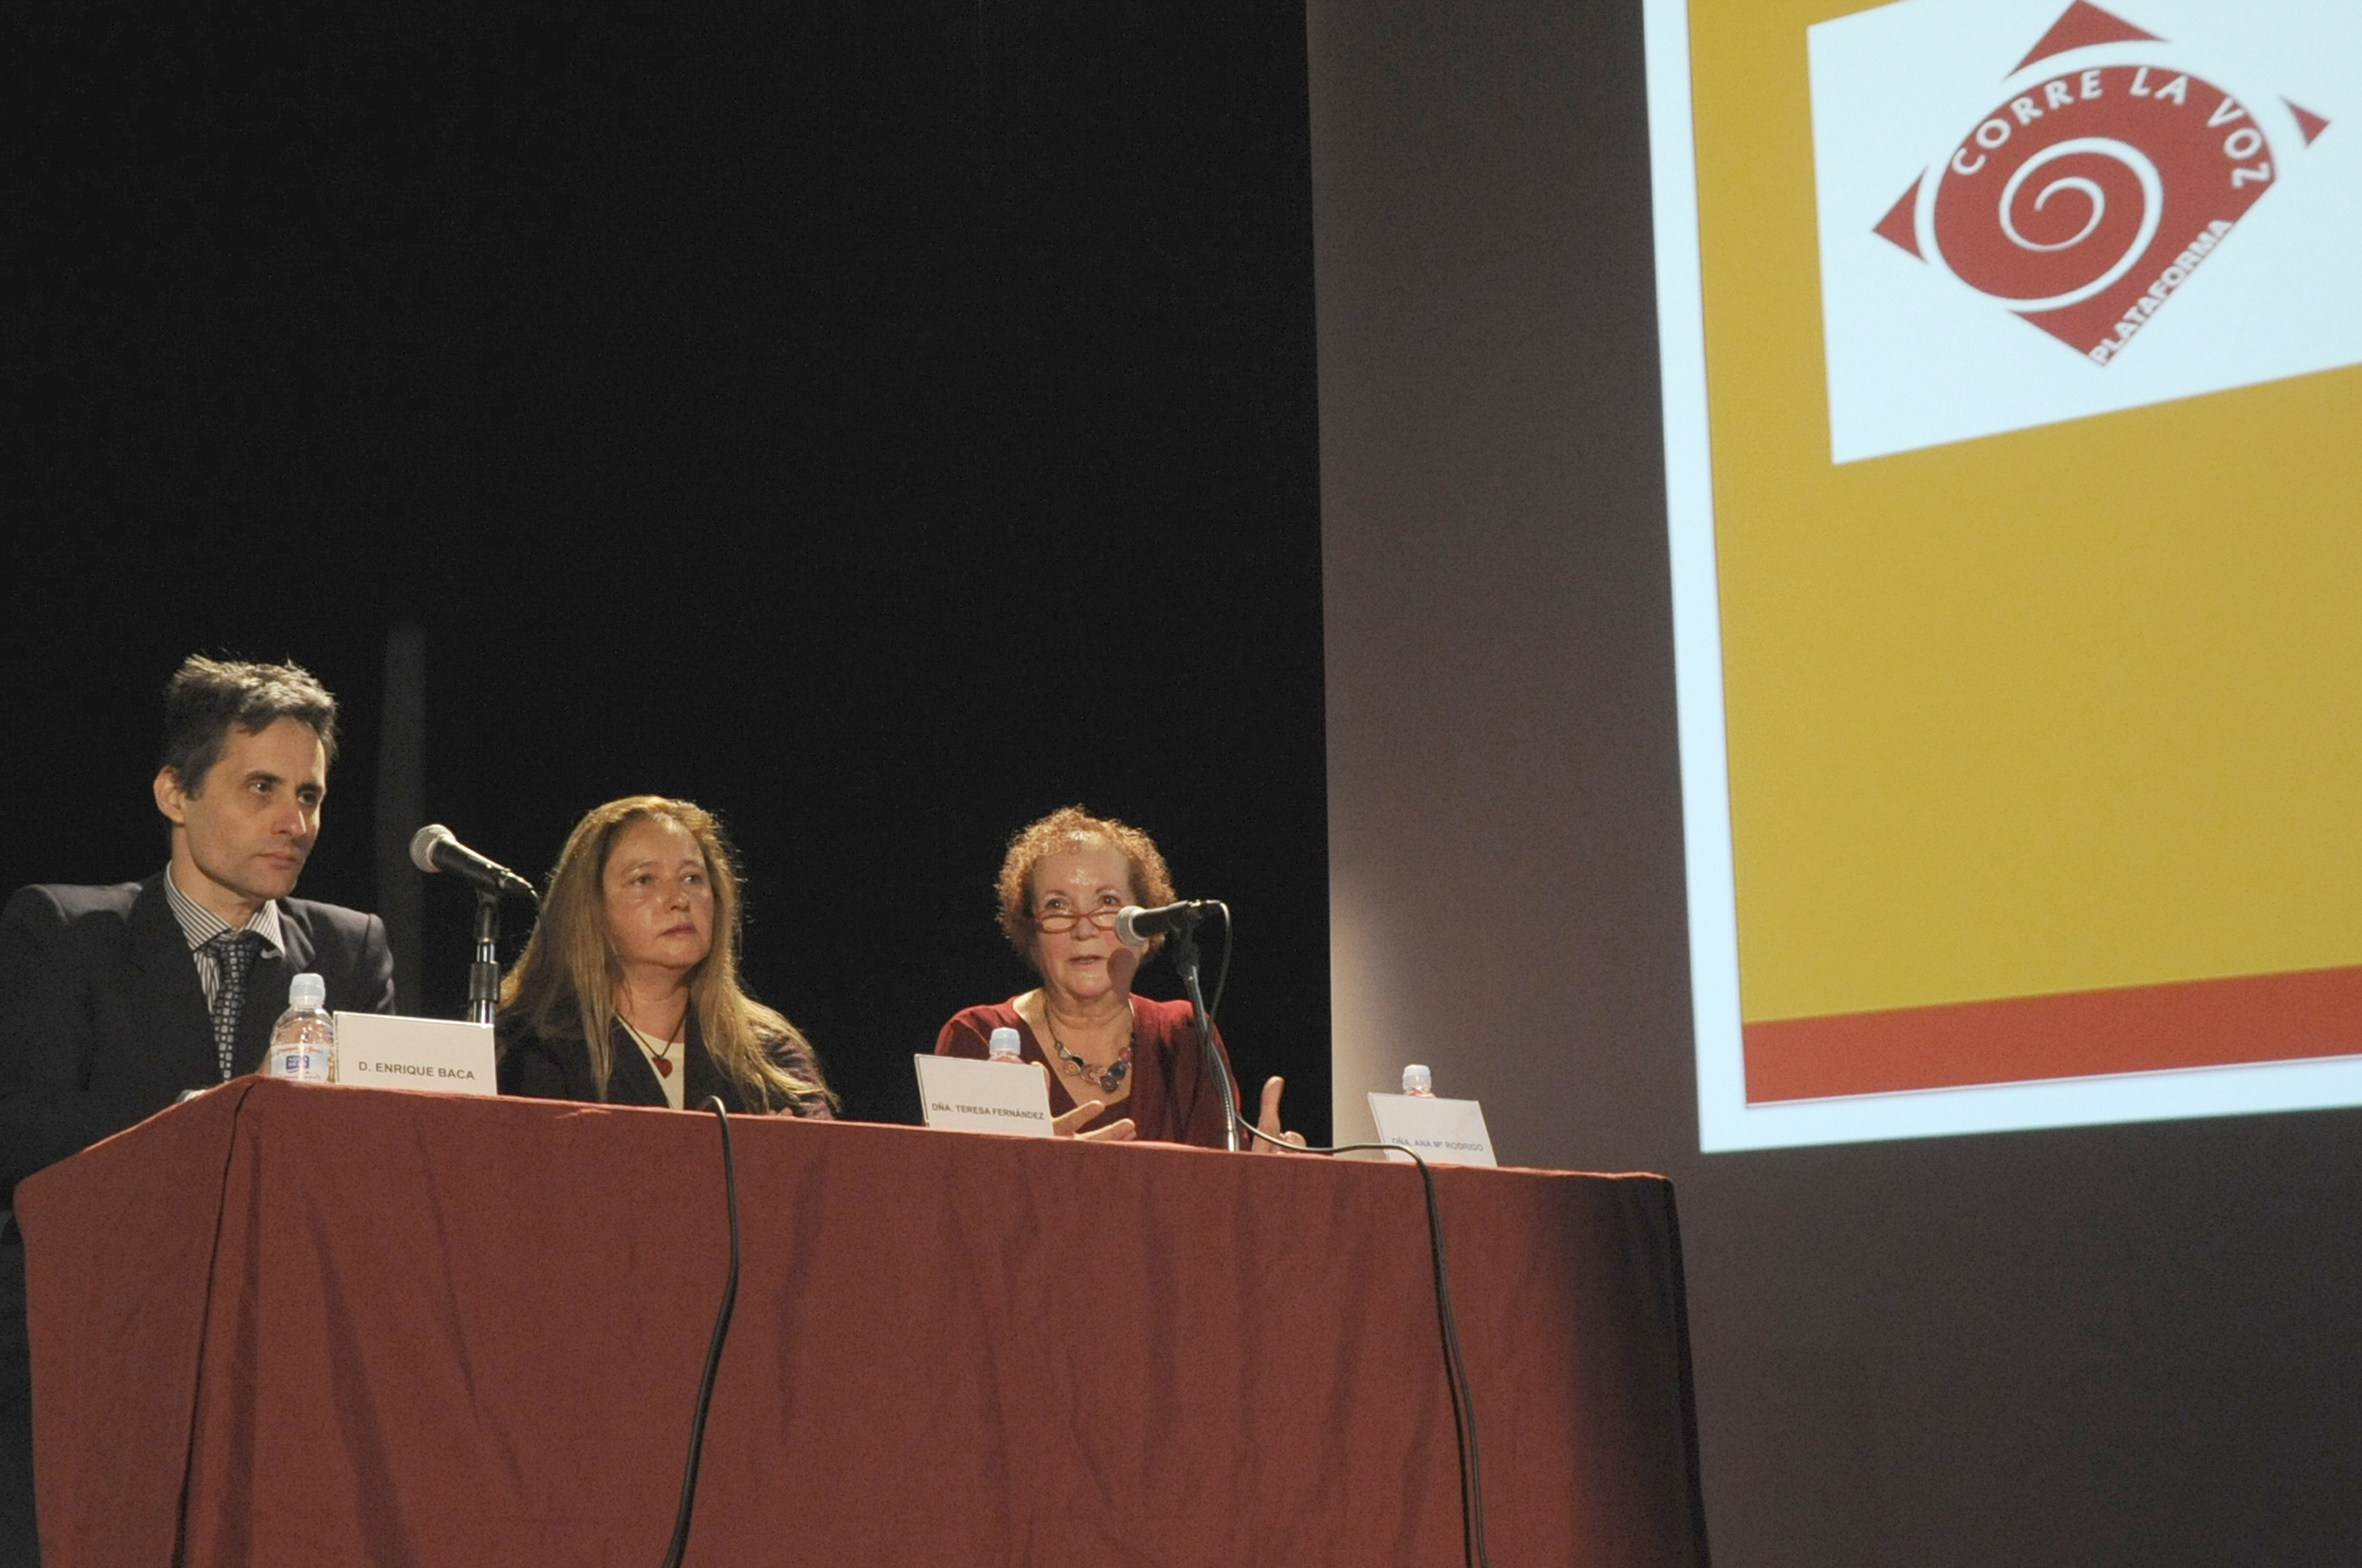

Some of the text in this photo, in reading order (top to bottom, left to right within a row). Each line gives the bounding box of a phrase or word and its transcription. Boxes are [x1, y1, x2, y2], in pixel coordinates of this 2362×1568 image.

[1951, 66, 2271, 188] CORRE LA VOZ
[2088, 219, 2234, 365] PLATAFORMA
[358, 1061, 475, 1080] D. ENRIQUE BACA
[932, 1101, 953, 1112] DÑA.
[955, 1105, 991, 1115] TERESA
[1414, 1140, 1432, 1148] ANA
[1444, 1141, 1484, 1152] RODRIGO
